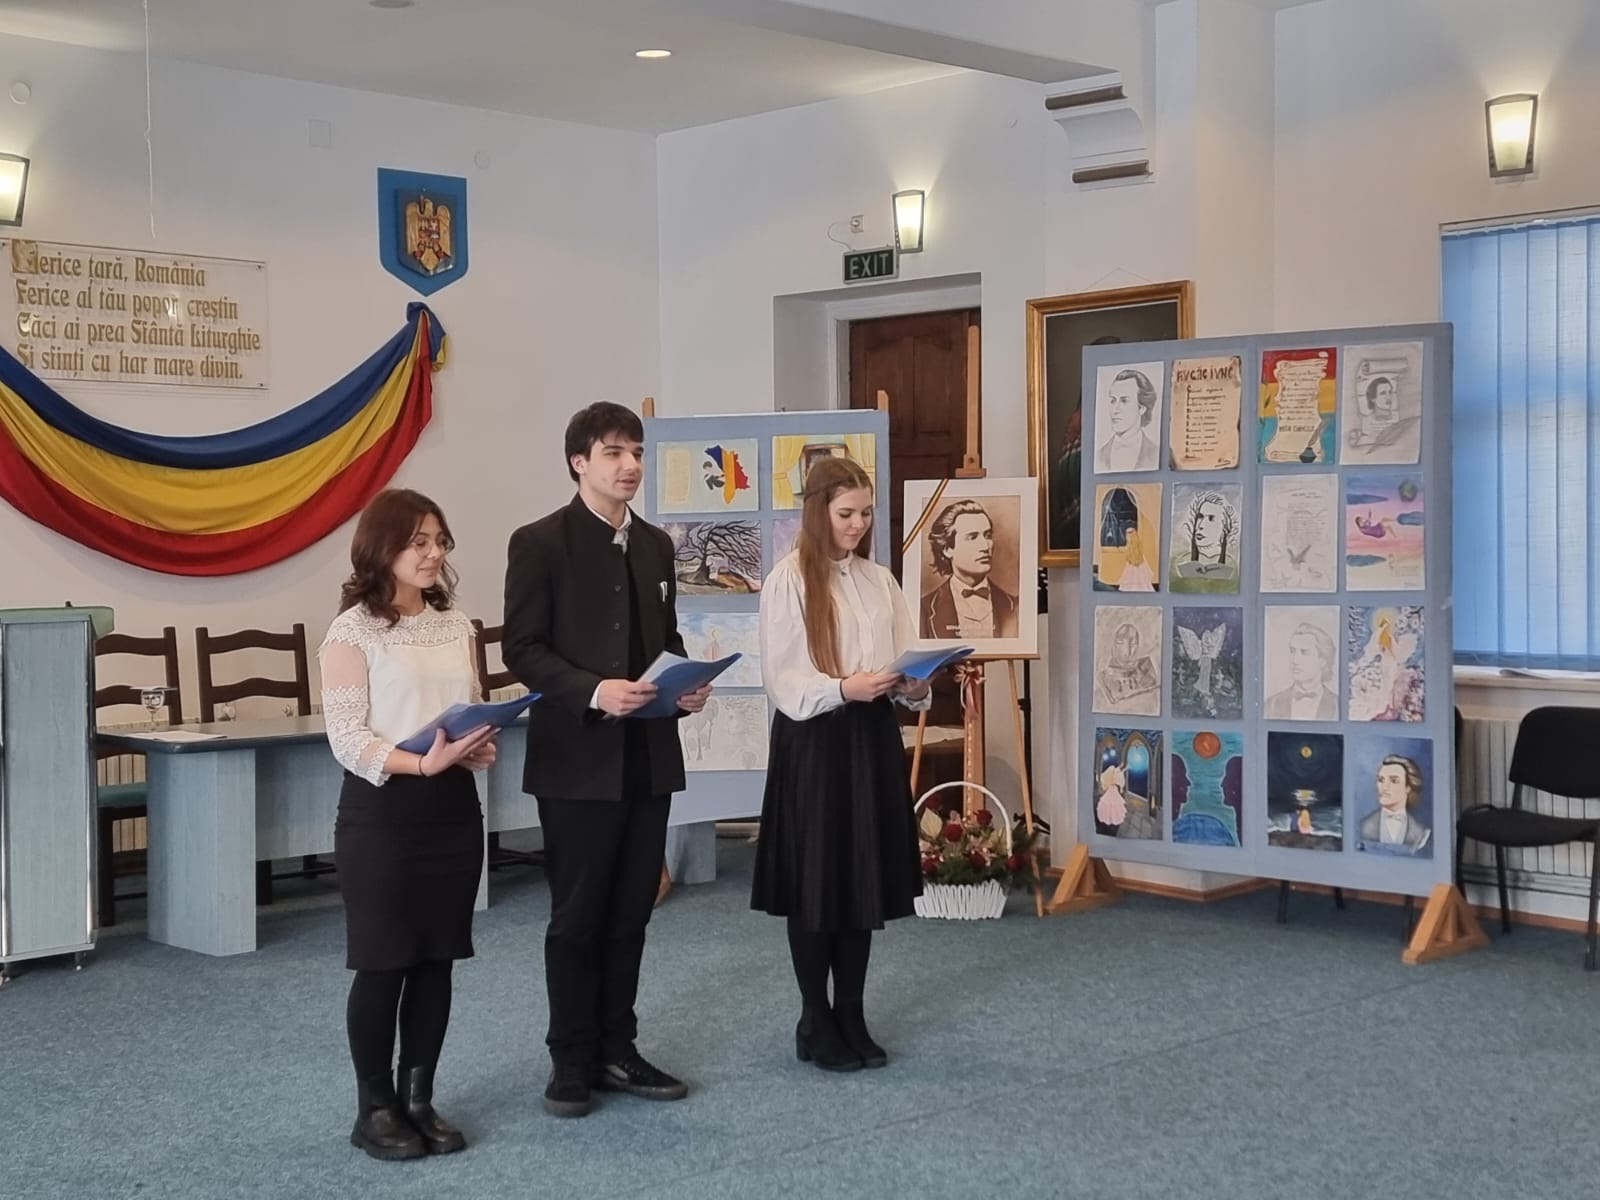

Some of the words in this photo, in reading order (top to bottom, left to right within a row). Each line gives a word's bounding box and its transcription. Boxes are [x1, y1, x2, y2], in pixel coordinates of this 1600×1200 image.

[134, 257, 206, 287] România
[849, 253, 889, 278] EXIT
[16, 279, 70, 307] Ferice
[76, 286, 93, 309] al
[100, 287, 126, 311] tău
[132, 294, 179, 319] popor
[187, 296, 239, 323] creștin
[17, 311, 57, 339] Căci
[64, 316, 81, 340] ai
[87, 322, 125, 346] prea
[131, 319, 185, 347] Sfântă
[190, 323, 261, 355] Liturghie
[91, 354, 110, 372] cu
[119, 349, 148, 374] har
[153, 357, 194, 377] mare
[200, 353, 243, 379] divin.
